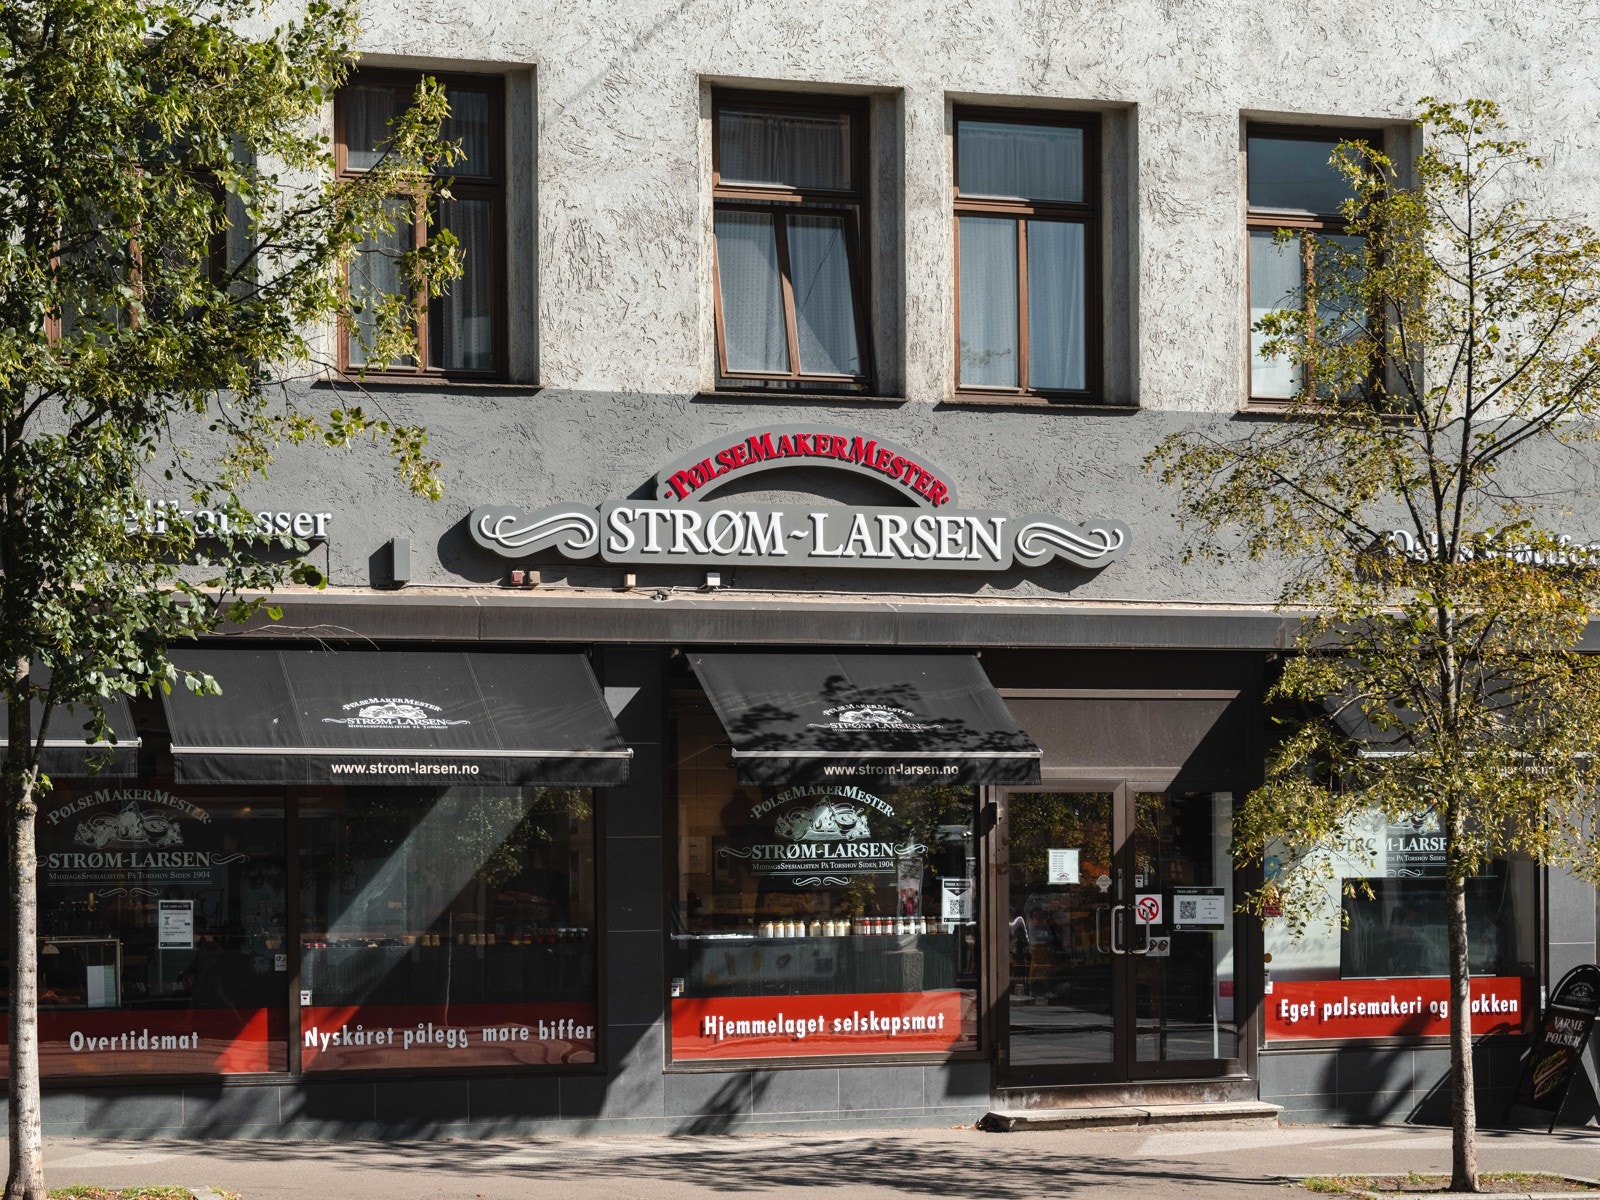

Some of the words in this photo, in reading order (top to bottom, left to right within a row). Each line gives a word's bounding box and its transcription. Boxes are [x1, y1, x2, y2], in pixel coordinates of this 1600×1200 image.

[667, 430, 949, 507] PØLSEMAKERMESTER
[331, 762, 480, 775] www.strom-larsen.no
[823, 763, 960, 776] www.strom-larsen.no
[878, 860, 894, 868] 1904
[193, 871, 210, 879] 1904
[1281, 998, 1316, 1022] Eget
[1324, 996, 1422, 1022] pølsemakeri
[1430, 1000, 1448, 1019] og
[705, 1012, 825, 1040] Hjemmelaget
[834, 1010, 945, 1036] selskapsmat
[1554, 1016, 1585, 1031] VARME
[69, 1028, 200, 1052] Overtidsmat
[304, 1023, 394, 1053] Nyskåret
[404, 1022, 469, 1050] pålegg
[483, 1023, 529, 1043] møre
[539, 1018, 594, 1041] biffer
[1545, 1031, 1581, 1047] PØLSER
